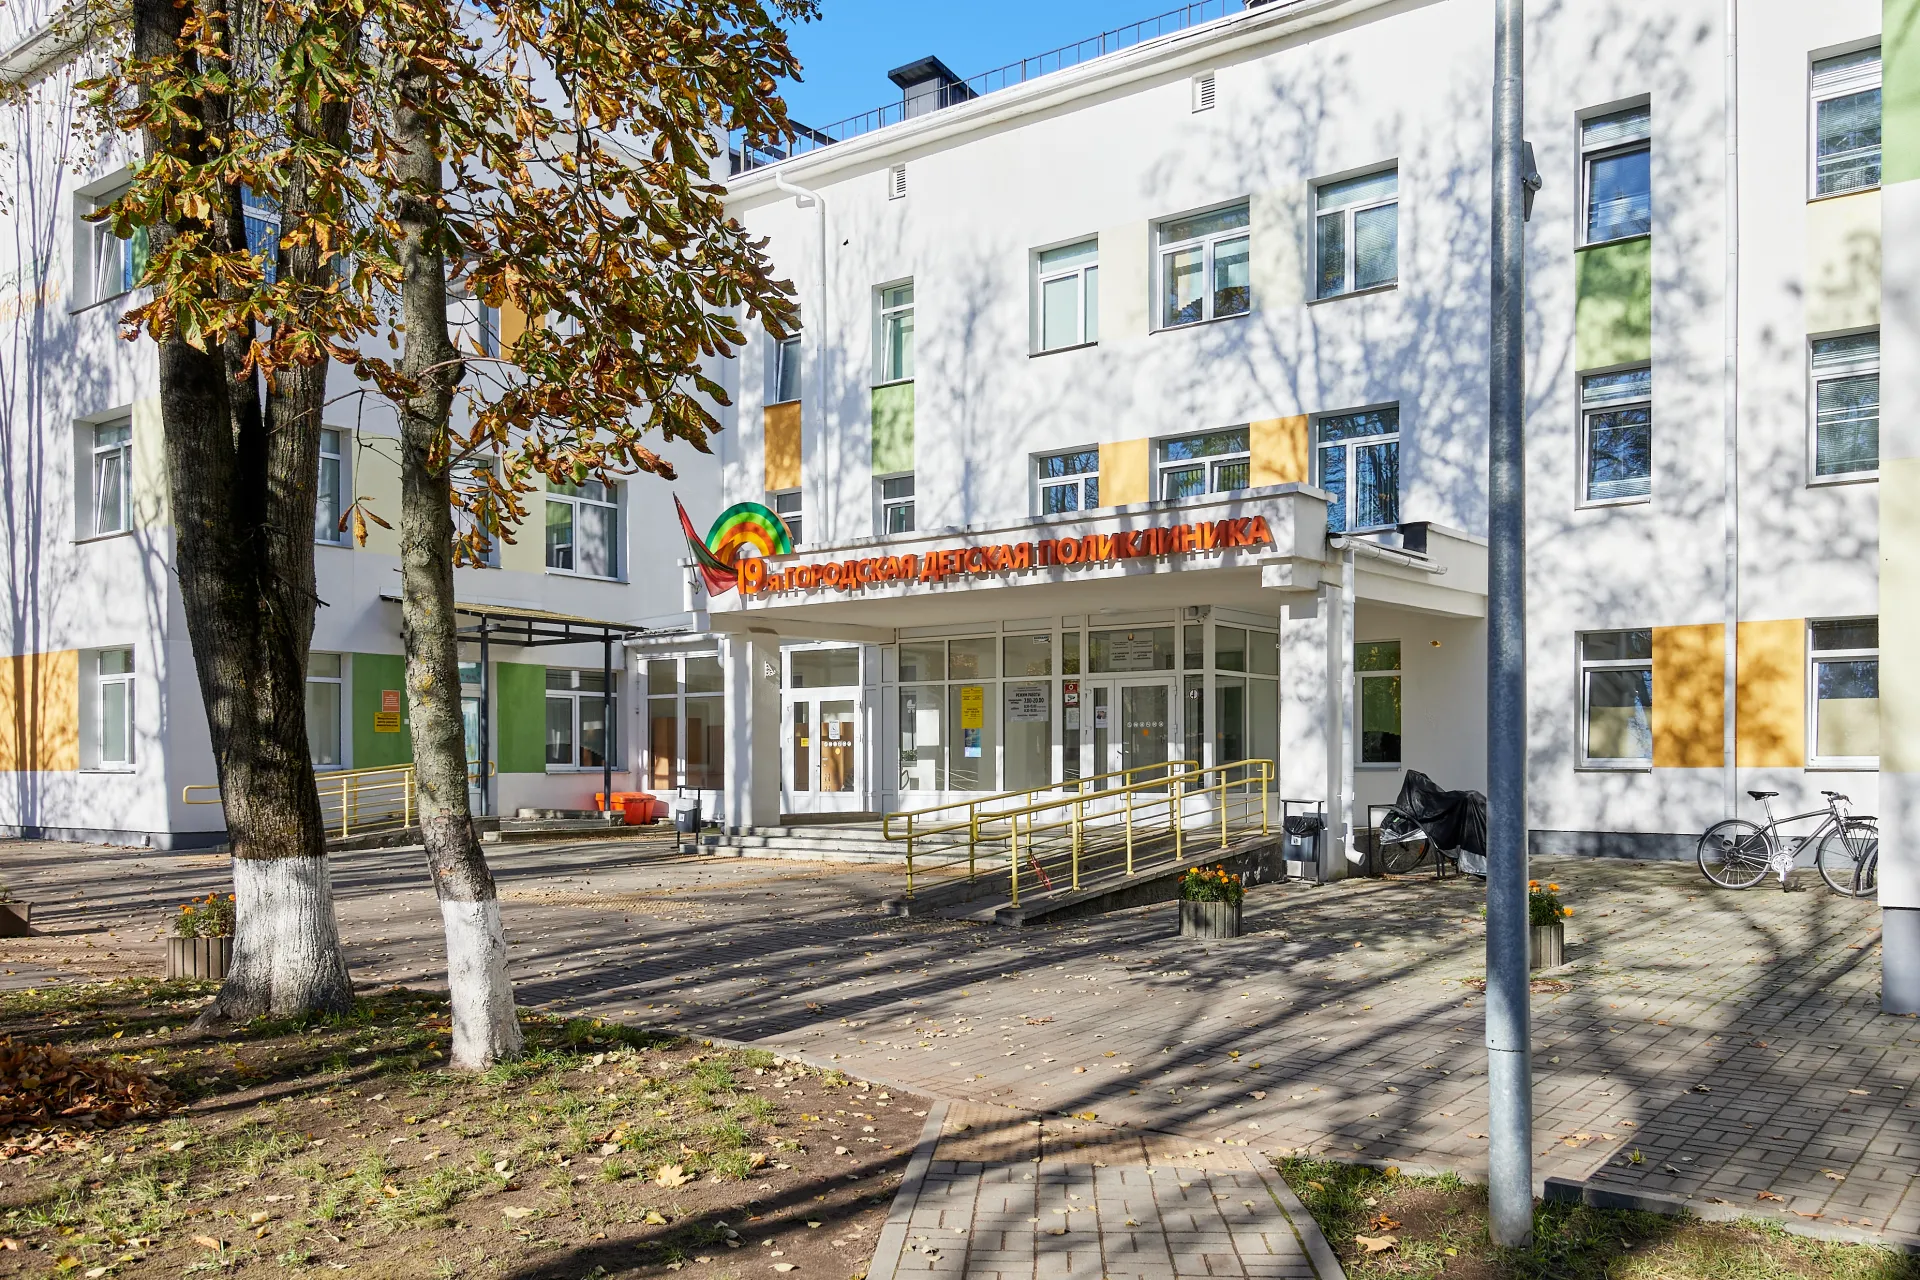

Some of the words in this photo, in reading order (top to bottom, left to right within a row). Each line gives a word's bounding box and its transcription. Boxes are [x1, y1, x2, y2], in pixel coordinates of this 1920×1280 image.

[784, 554, 918, 590] ГОРОДСКАЯ
[920, 542, 1033, 583] ДЕТСКАЯ
[1038, 515, 1273, 566] ПОЛИКЛИНИКА
